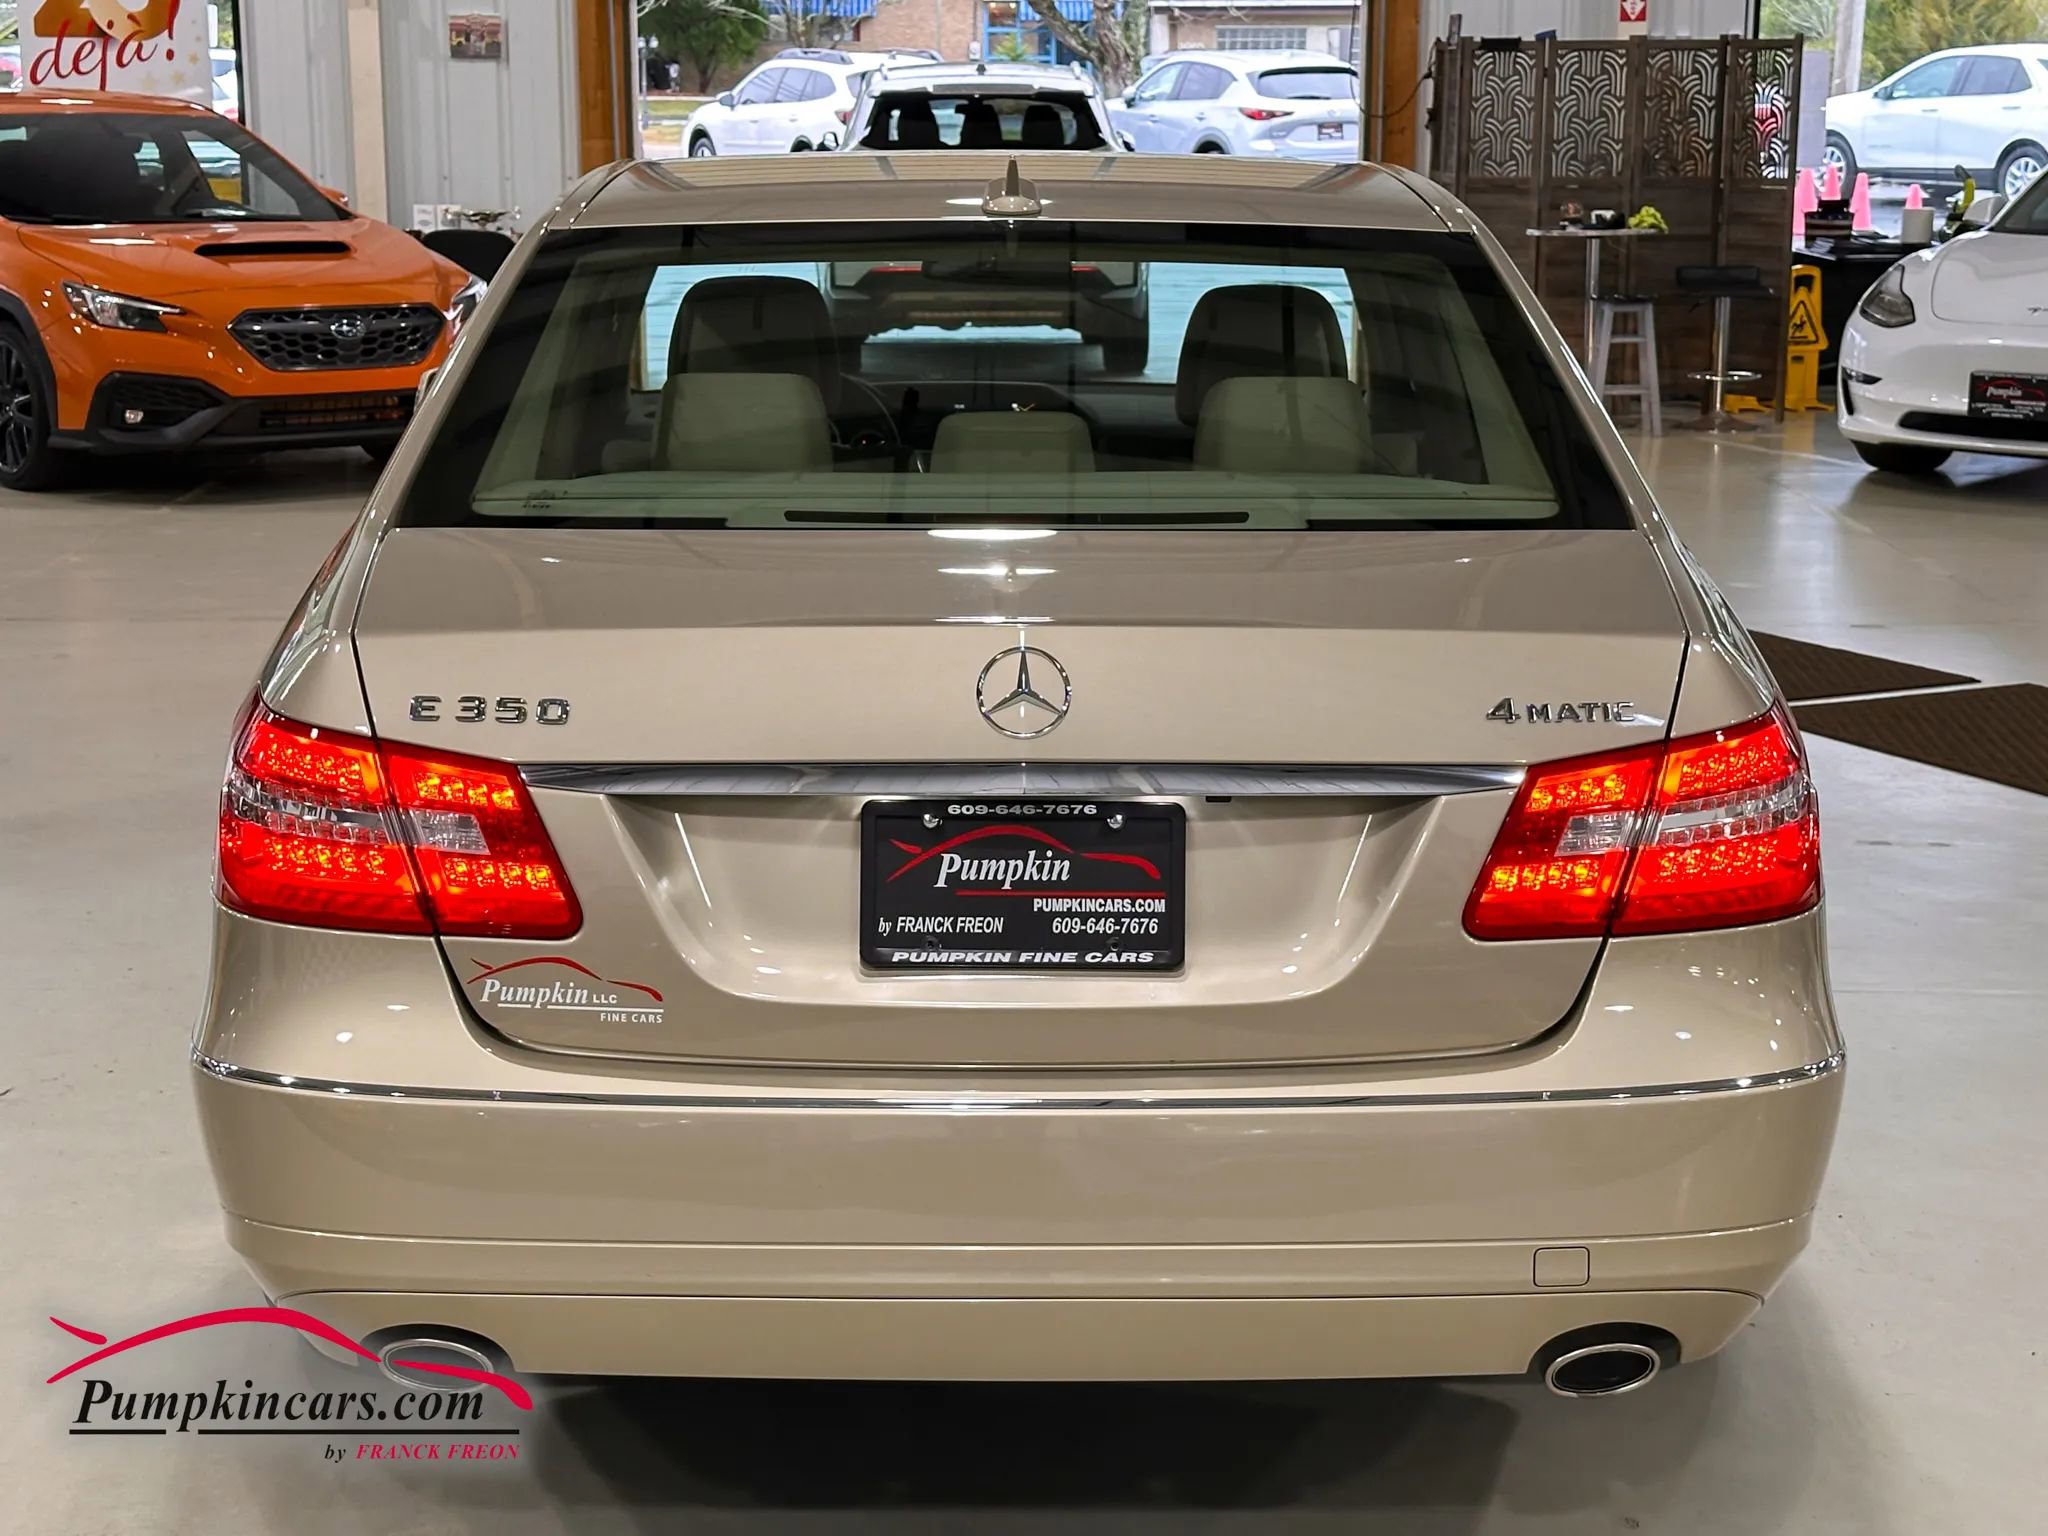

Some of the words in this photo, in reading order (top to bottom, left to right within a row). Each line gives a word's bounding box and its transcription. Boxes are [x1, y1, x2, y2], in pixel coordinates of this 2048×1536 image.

[947, 804, 1098, 816] 609-646-7676
[933, 850, 1071, 890] Pumpkin
[1033, 898, 1166, 913] PUMPKINCARS.COM
[878, 918, 892, 936] by
[896, 917, 954, 933] FRANCK
[956, 917, 1004, 933] FREON
[1052, 917, 1159, 934] 609-646-7676
[891, 951, 1011, 963] PUMPKIN
[1018, 951, 1078, 963] FINE
[1085, 951, 1154, 963] CARS
[480, 978, 589, 1008] Pumpkin
[593, 994, 617, 1004] LLC
[600, 1012, 627, 1023] FINE
[632, 1013, 663, 1024] CARS
